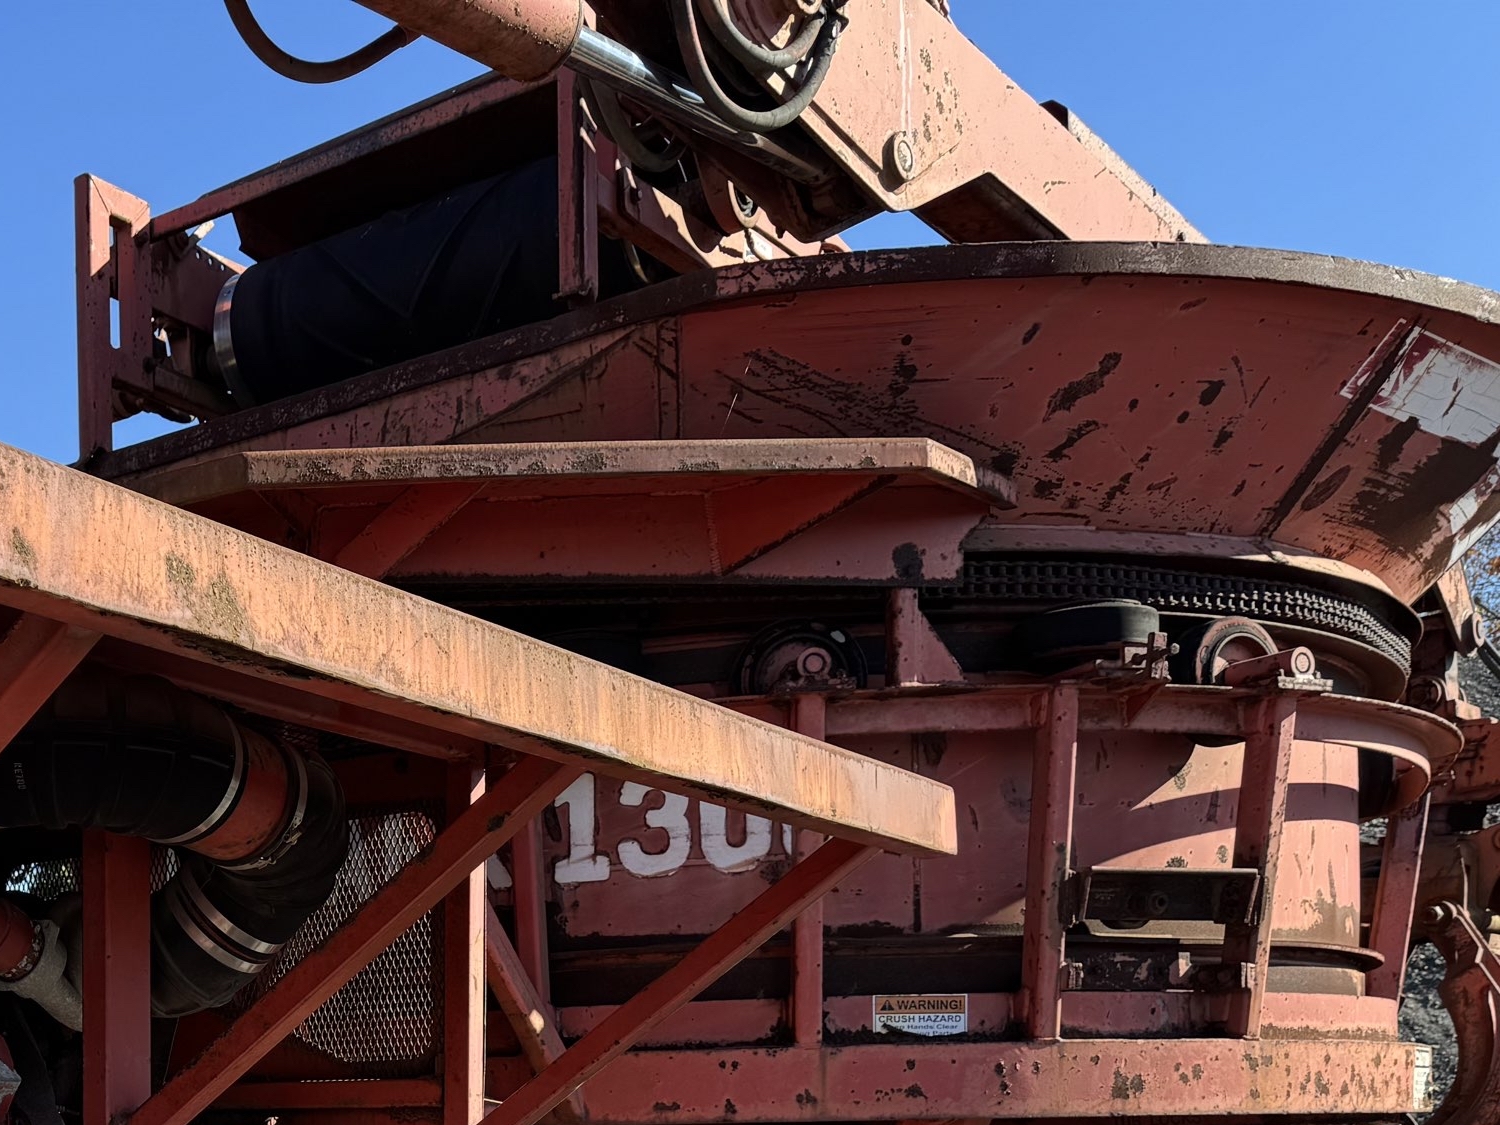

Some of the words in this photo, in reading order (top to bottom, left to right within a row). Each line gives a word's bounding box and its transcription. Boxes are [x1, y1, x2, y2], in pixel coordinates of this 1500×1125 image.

[554, 771, 793, 884] 130
[897, 999, 962, 1010] WARNING!
[878, 1015, 915, 1023] CRUSH
[918, 1015, 962, 1023] HAZARD
